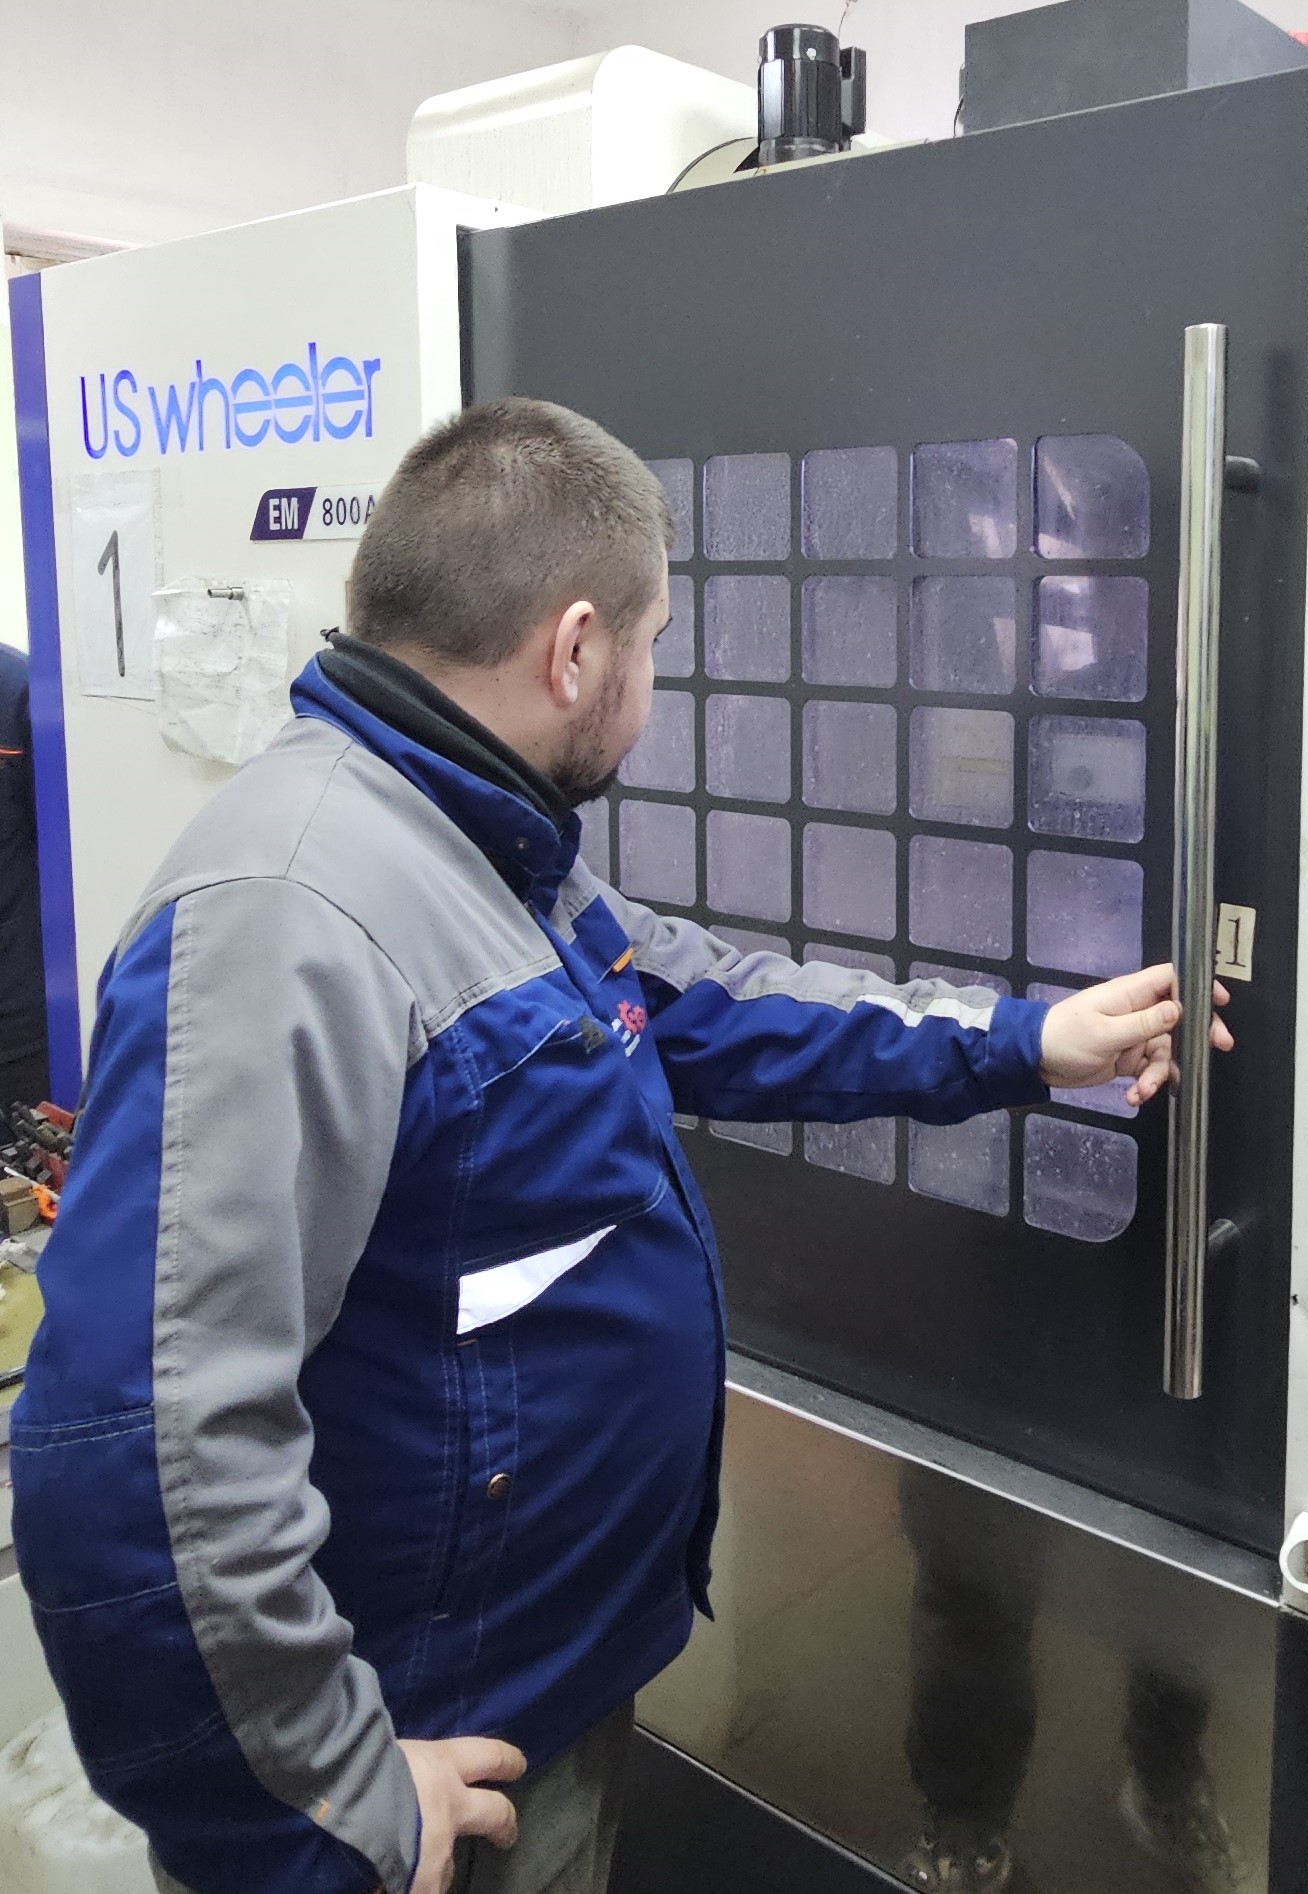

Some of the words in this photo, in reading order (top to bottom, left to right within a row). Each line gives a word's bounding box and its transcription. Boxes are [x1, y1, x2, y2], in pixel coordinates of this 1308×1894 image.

[79, 368, 142, 460] US
[147, 341, 382, 455] wheeler
[268, 497, 301, 531] EM
[97, 530, 126, 678] 1
